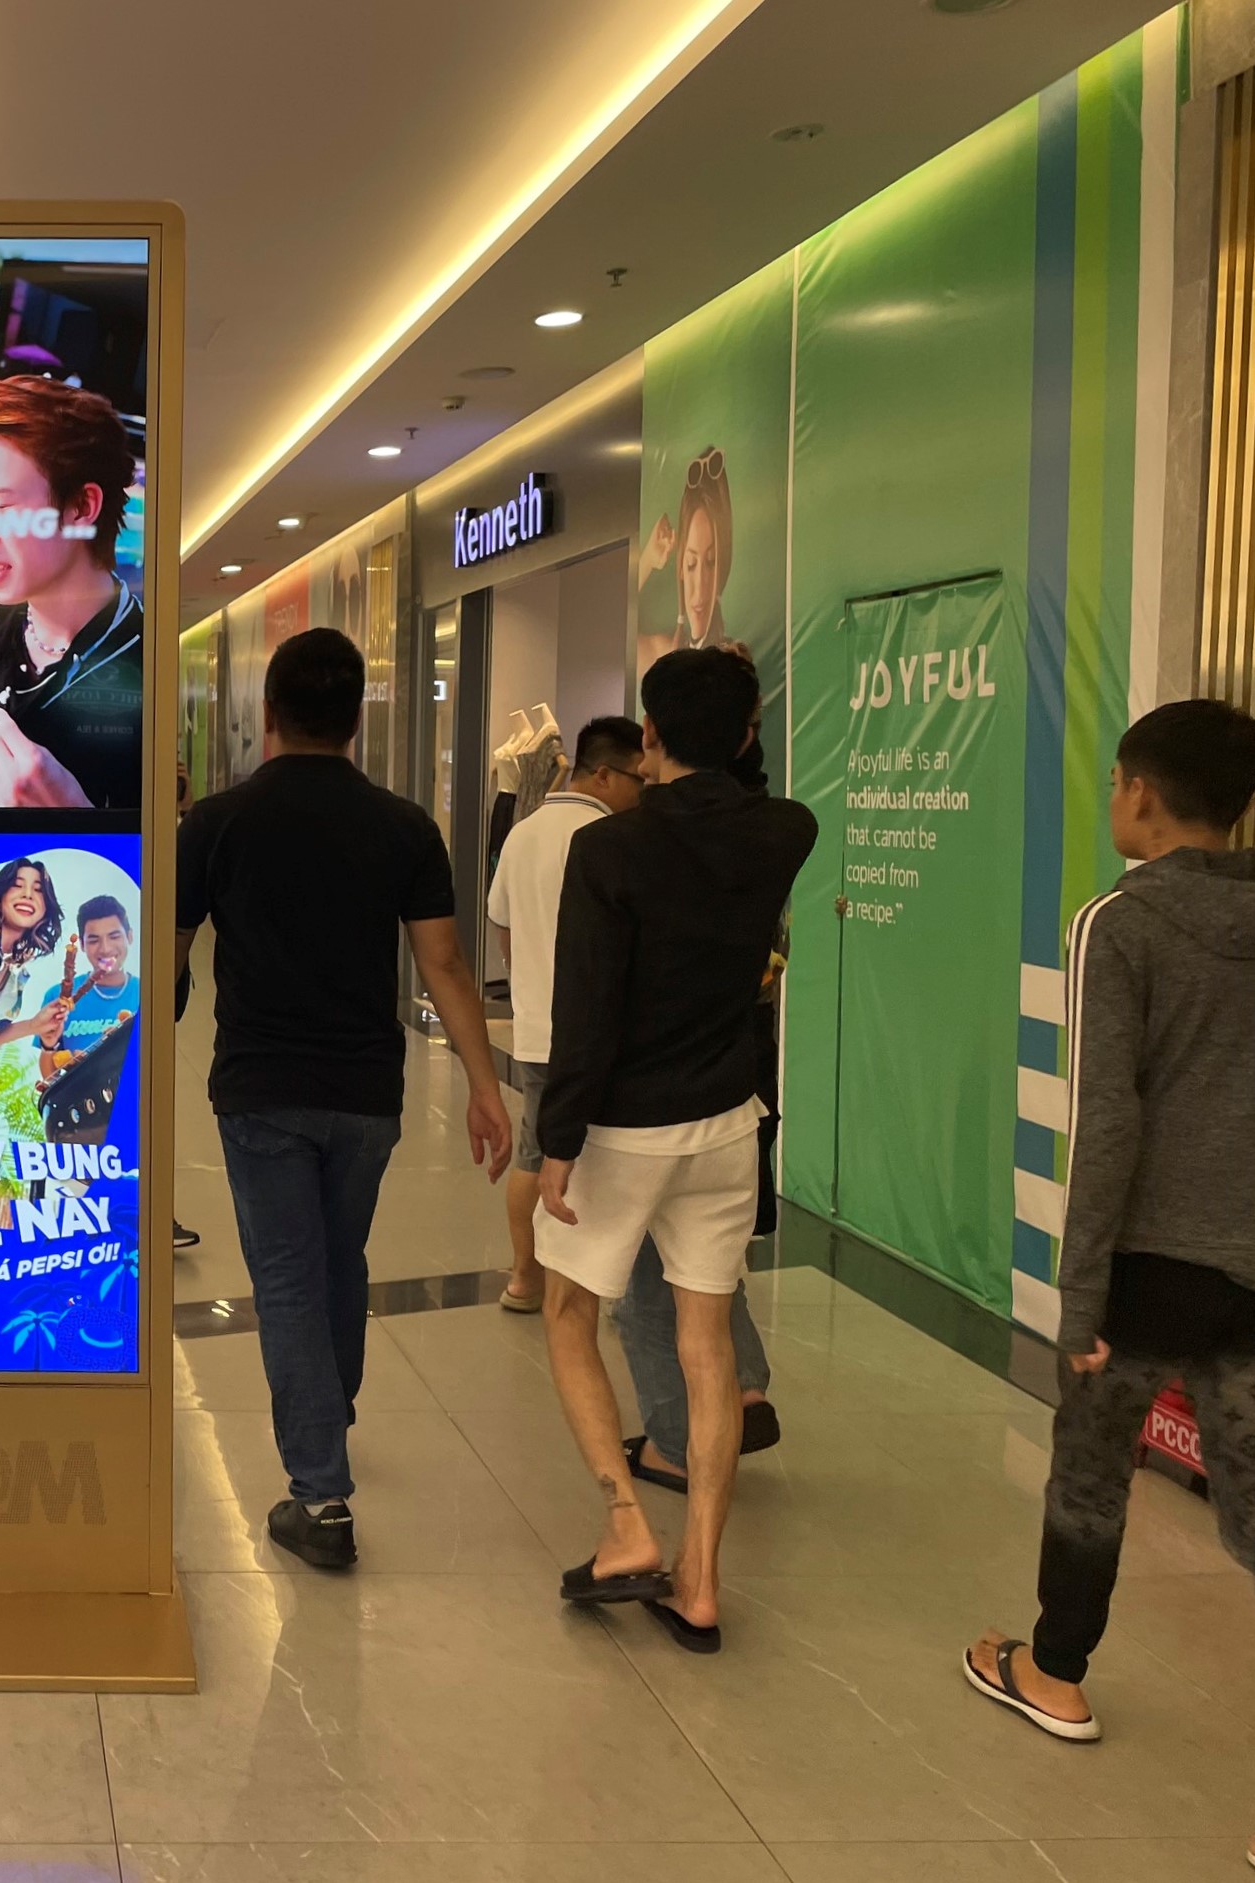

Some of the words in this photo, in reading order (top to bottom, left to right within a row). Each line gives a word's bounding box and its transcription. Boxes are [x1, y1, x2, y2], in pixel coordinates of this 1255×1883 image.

[454, 471, 543, 569] Kenneth
[849, 644, 996, 711] JOYFUL
[857, 748, 893, 778] joyful
[896, 747, 914, 772] life
[917, 746, 931, 771] is
[934, 751, 950, 771] an
[846, 785, 910, 810] individual
[913, 784, 970, 811] creation
[847, 823, 871, 847] that
[873, 826, 916, 850] cannot
[919, 825, 937, 851] be
[846, 859, 886, 889] copied
[889, 862, 919, 888] from
[845, 900, 853, 918] a
[14, 1141, 123, 1181] BUNG
[16, 1186, 112, 1244] NÀY
[16, 1250, 83, 1280] PEPSI
[1151, 1410, 1202, 1462] PCCC
